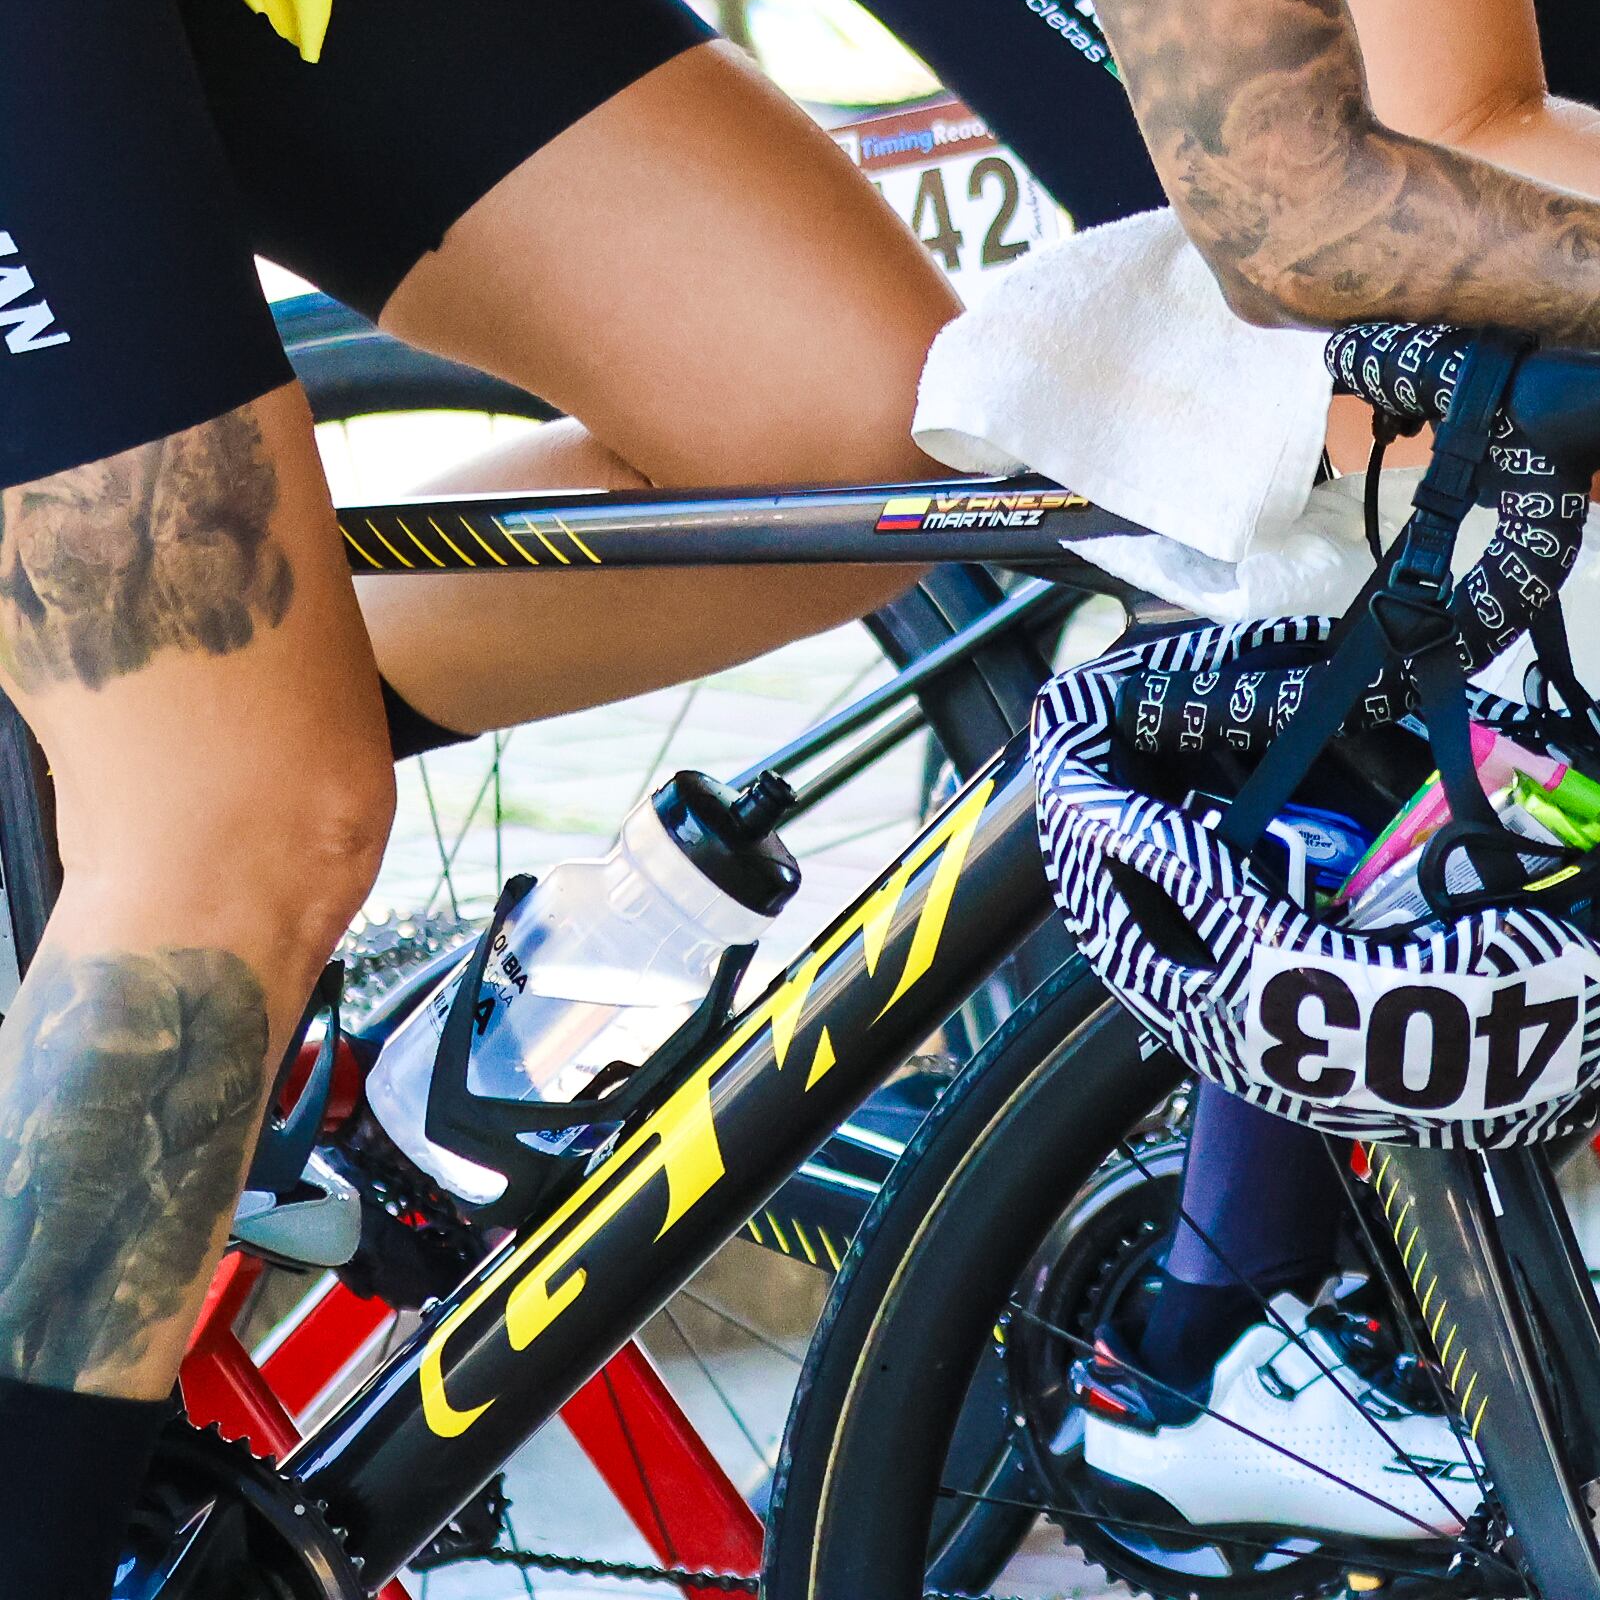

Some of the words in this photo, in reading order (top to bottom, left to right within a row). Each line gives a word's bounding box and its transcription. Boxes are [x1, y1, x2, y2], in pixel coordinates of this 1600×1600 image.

[873, 157, 1031, 272] 42
[922, 510, 1045, 530] MARTINEZ
[935, 491, 1089, 512] VANESA
[1260, 967, 1579, 1111] 403
